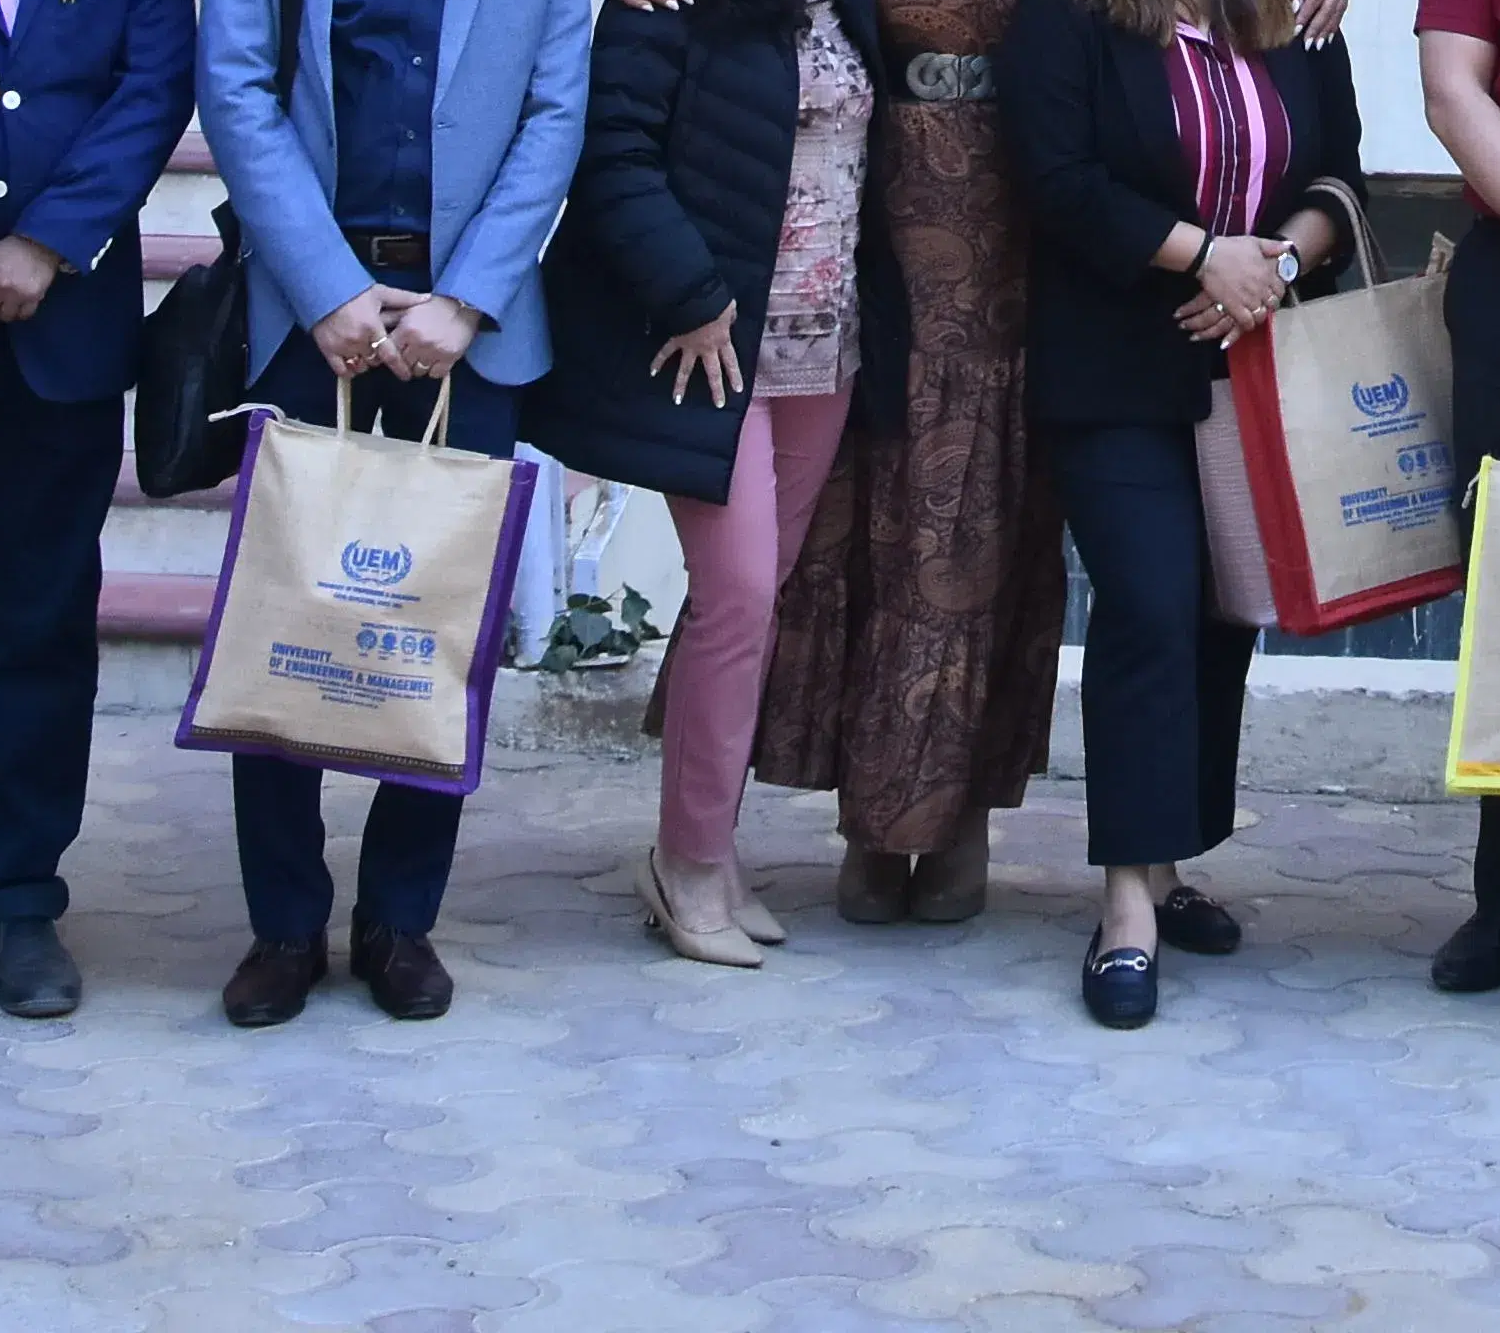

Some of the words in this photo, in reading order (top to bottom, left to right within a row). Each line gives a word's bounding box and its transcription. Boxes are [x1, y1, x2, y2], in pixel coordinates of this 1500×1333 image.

[1359, 380, 1400, 405] UEM
[352, 548, 400, 571] UEM
[271, 641, 332, 663] UNIVERSITY
[269, 656, 284, 668] OF
[285, 659, 353, 681] ENGINEERING
[367, 673, 433, 693] MANAGEMENT
